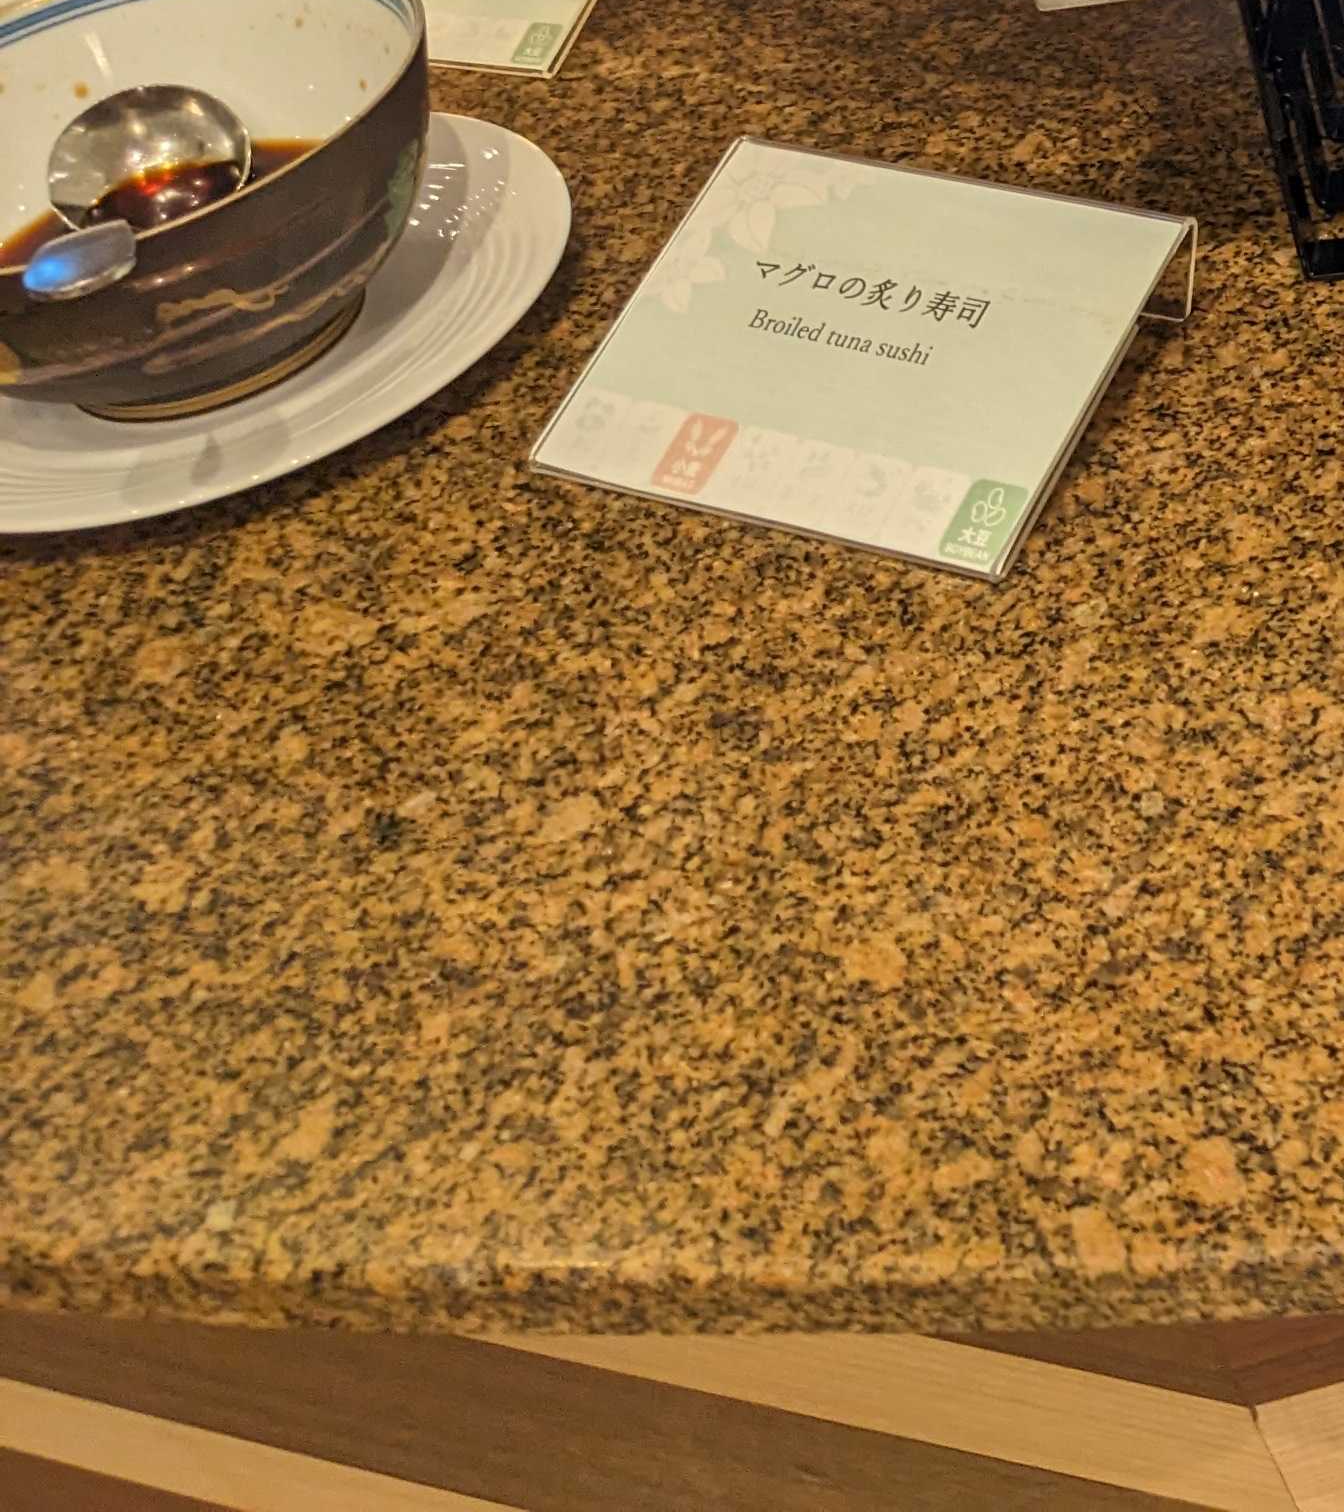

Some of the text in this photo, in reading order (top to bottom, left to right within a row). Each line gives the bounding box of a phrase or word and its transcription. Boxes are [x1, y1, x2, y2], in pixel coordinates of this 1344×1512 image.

[756, 260, 991, 329] マグロの炙り寿司
[748, 309, 934, 366] Broiled tuna sushi
[957, 527, 992, 546] 大豆
